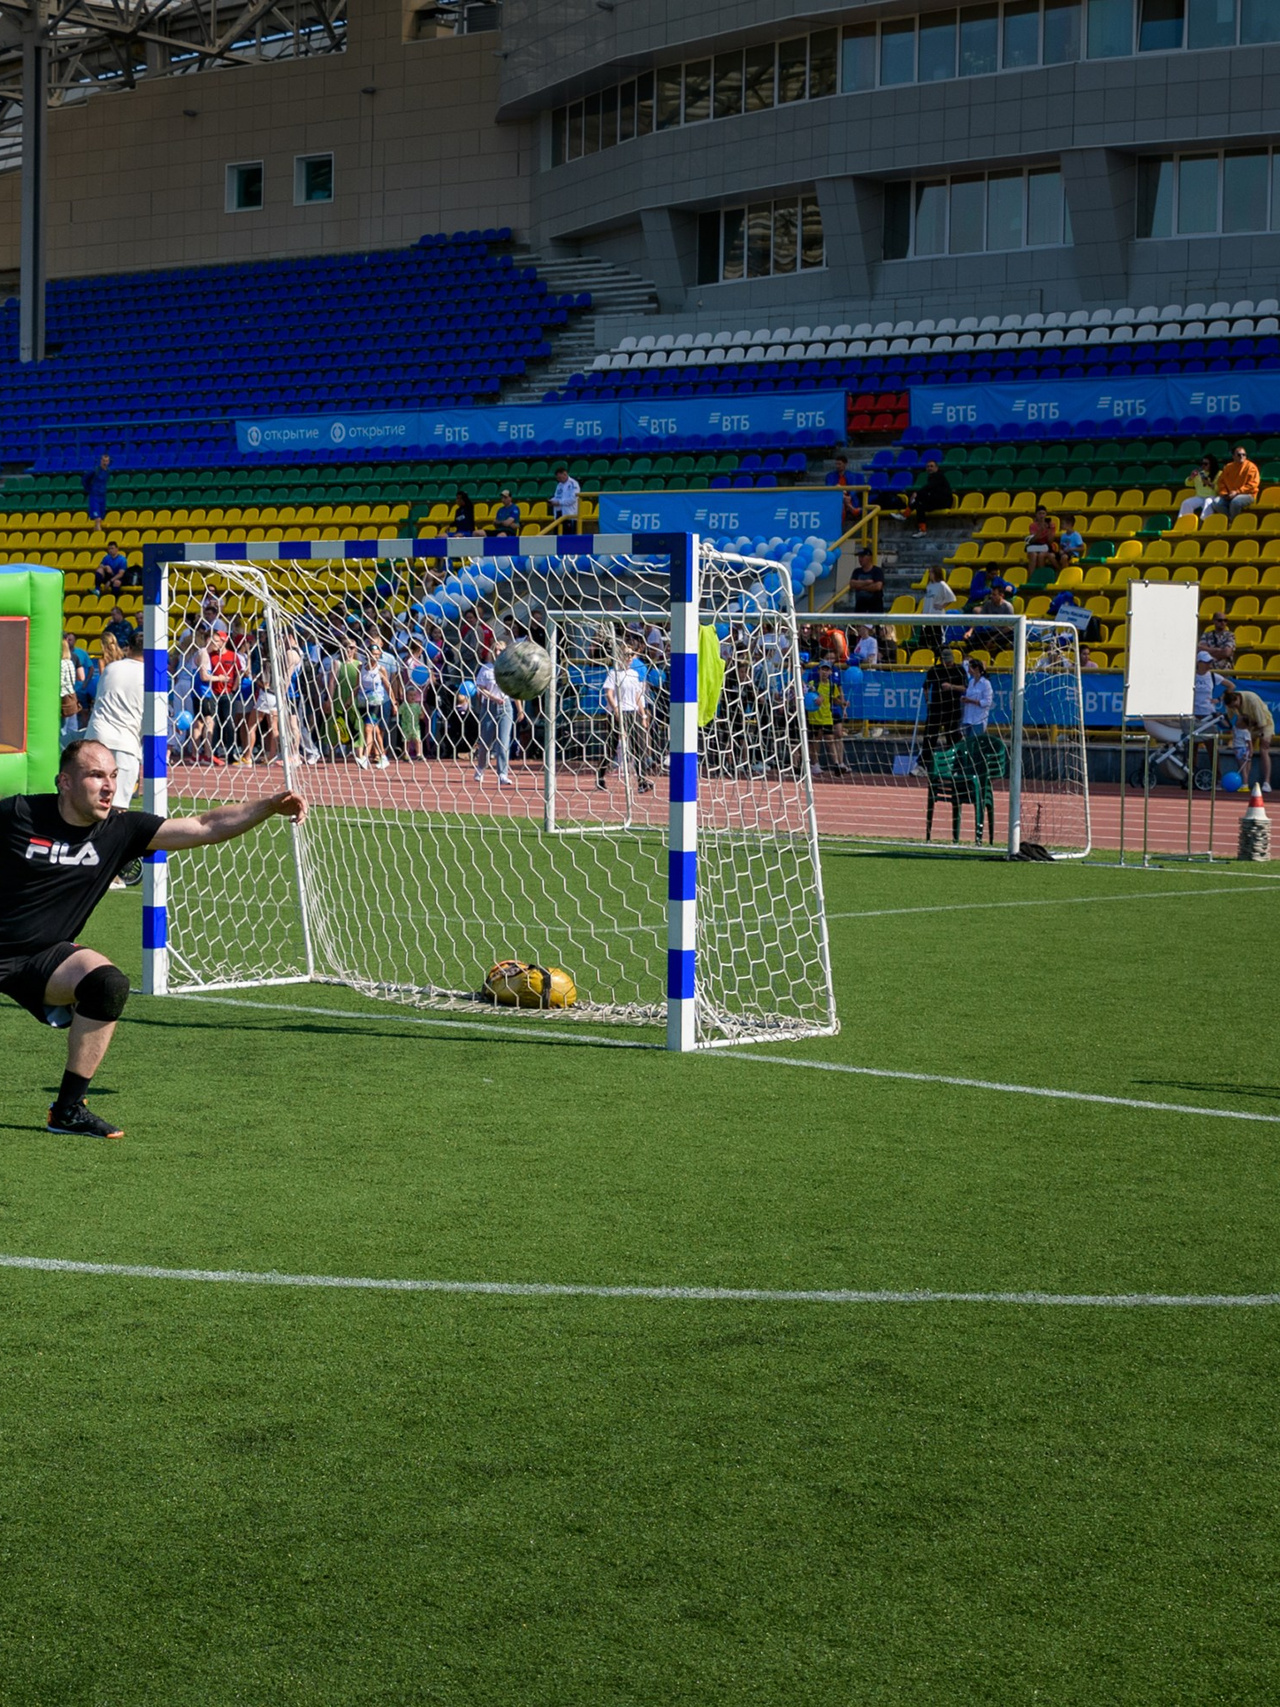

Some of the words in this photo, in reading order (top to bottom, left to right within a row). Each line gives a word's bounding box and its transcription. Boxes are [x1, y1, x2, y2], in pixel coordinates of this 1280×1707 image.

[946, 405, 977, 422] ВТБ
[1028, 402, 1059, 420] ВТБ
[1113, 399, 1147, 417] ВТБ
[1207, 395, 1241, 413] ВТБ
[263, 428, 320, 443] открытие
[348, 424, 406, 439] открытие
[445, 427, 469, 442] ВТБ
[510, 424, 535, 439] ВТБ
[576, 420, 602, 436] ВТБ
[650, 418, 677, 434] ВТБ
[722, 415, 750, 431] ВТБ
[797, 411, 825, 427] ВТБ
[631, 513, 660, 530] ВТБ
[708, 512, 739, 530] ВТБ
[789, 511, 820, 529] ВТБ
[884, 688, 920, 708] ВТБ
[1085, 691, 1124, 713] ВТБ
[25, 837, 100, 866] FILA
